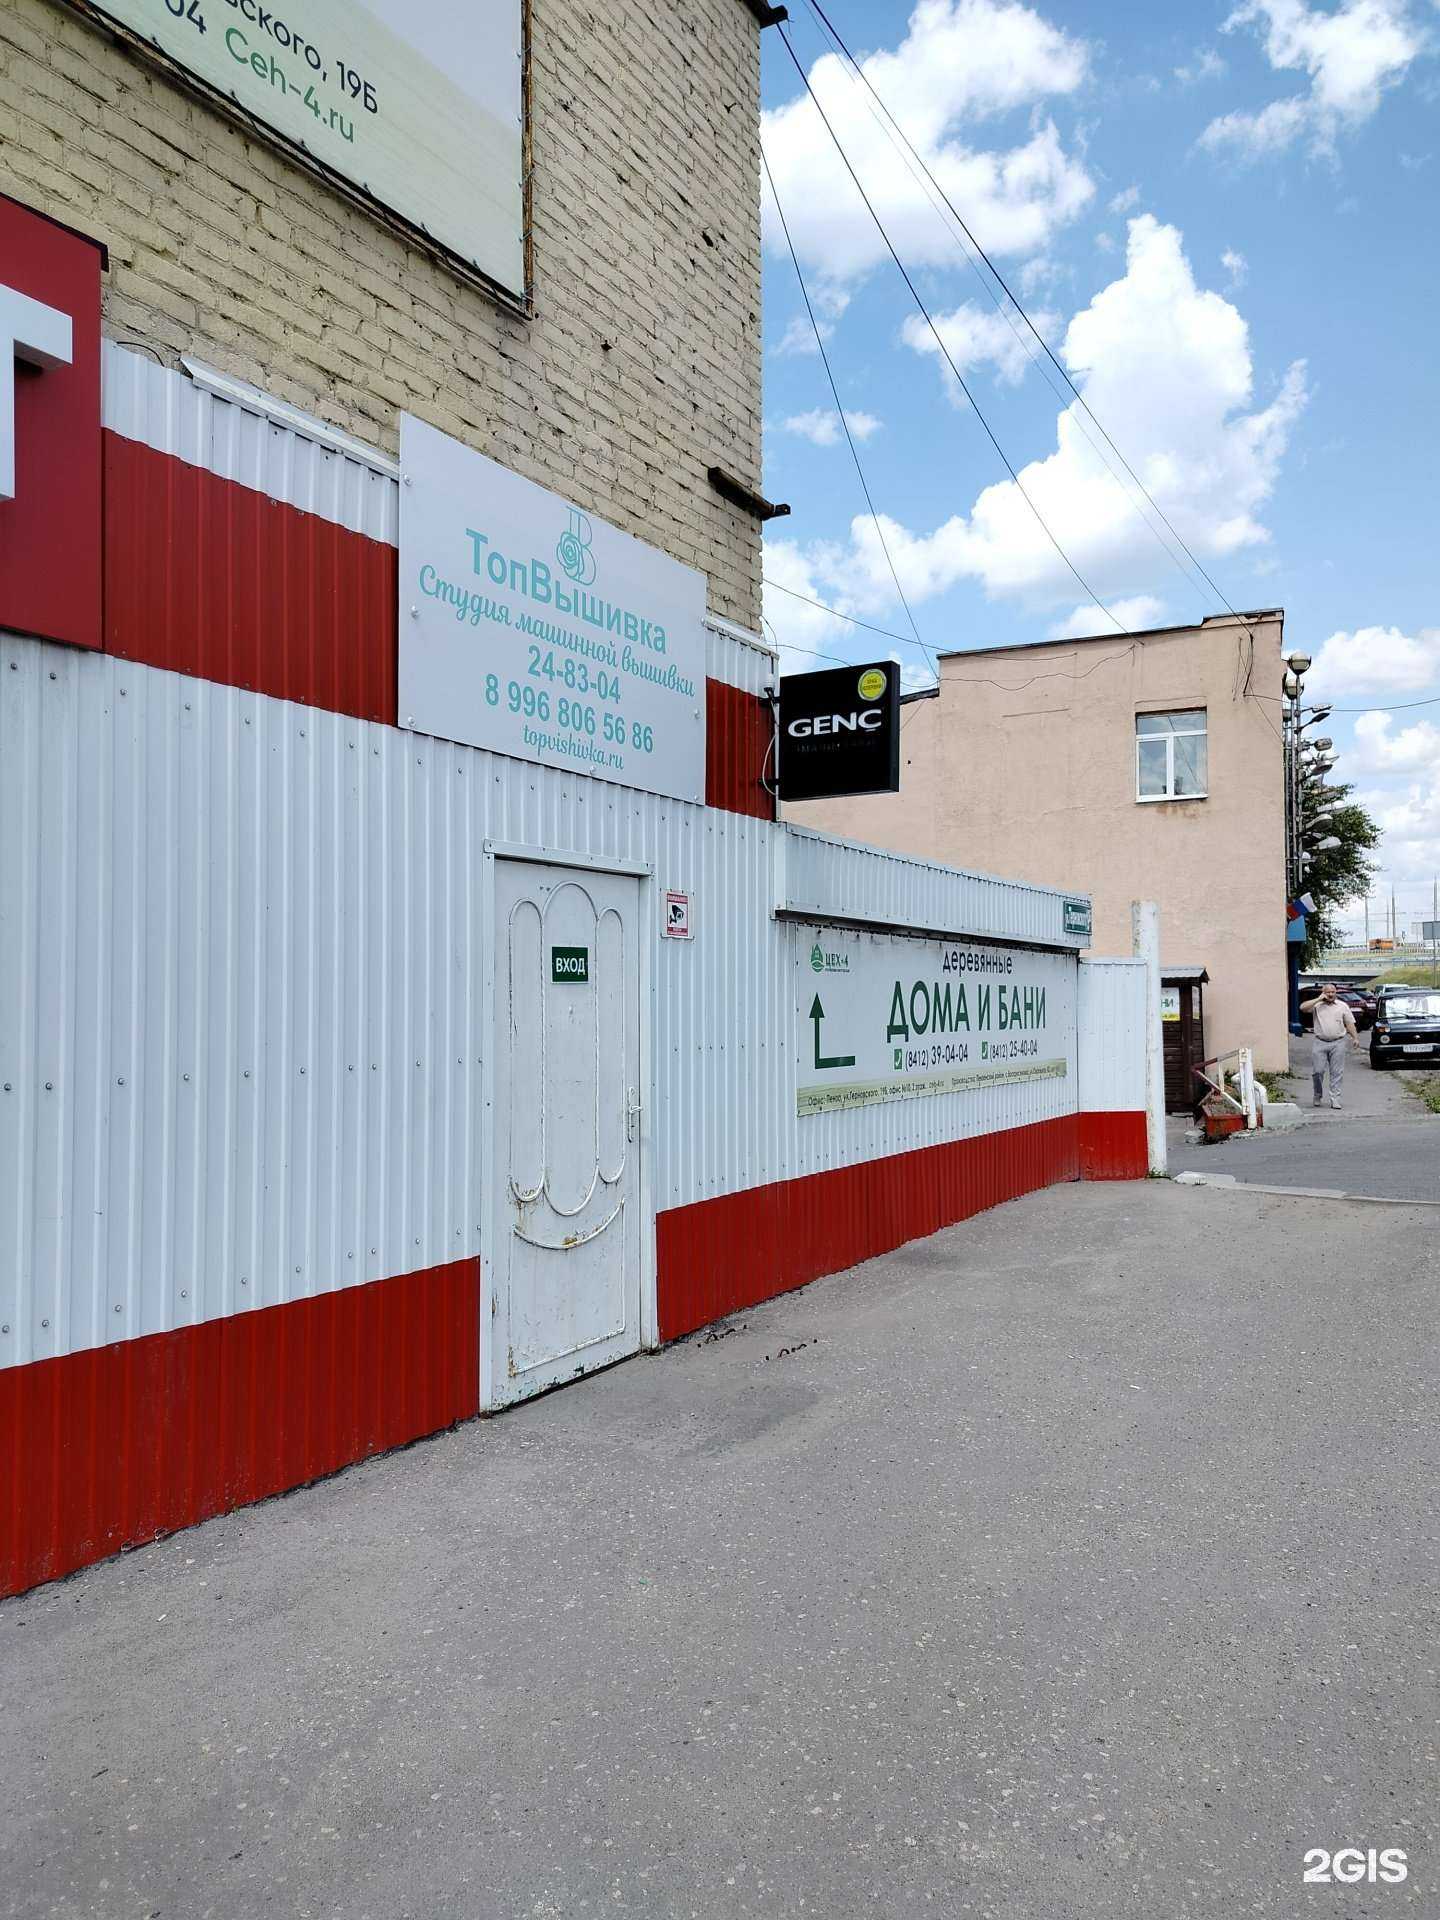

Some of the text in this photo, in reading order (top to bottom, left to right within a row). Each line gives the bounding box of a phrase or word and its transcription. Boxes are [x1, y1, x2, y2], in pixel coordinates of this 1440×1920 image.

[225, 27, 354, 143] Ceh-4.ru
[336, 60, 378, 114] 19Б
[466, 527, 666, 654] ТопВышивка
[419, 564, 696, 697] Студия машинной вышивки
[528, 645, 621, 704] 24-83-04
[485, 674, 653, 753] 8 996 806 56 86
[523, 724, 625, 770] topvishivka.ru
[555, 957, 586, 975] ВХОД
[825, 953, 849, 968] ЦЕХ-4
[943, 951, 1013, 977] деревянные
[887, 980, 1046, 1043] ДОМА И БАНИ
[905, 1043, 968, 1072] (8412) 39-04-04
[989, 1039, 1038, 1062] (8412) 25-40-04
